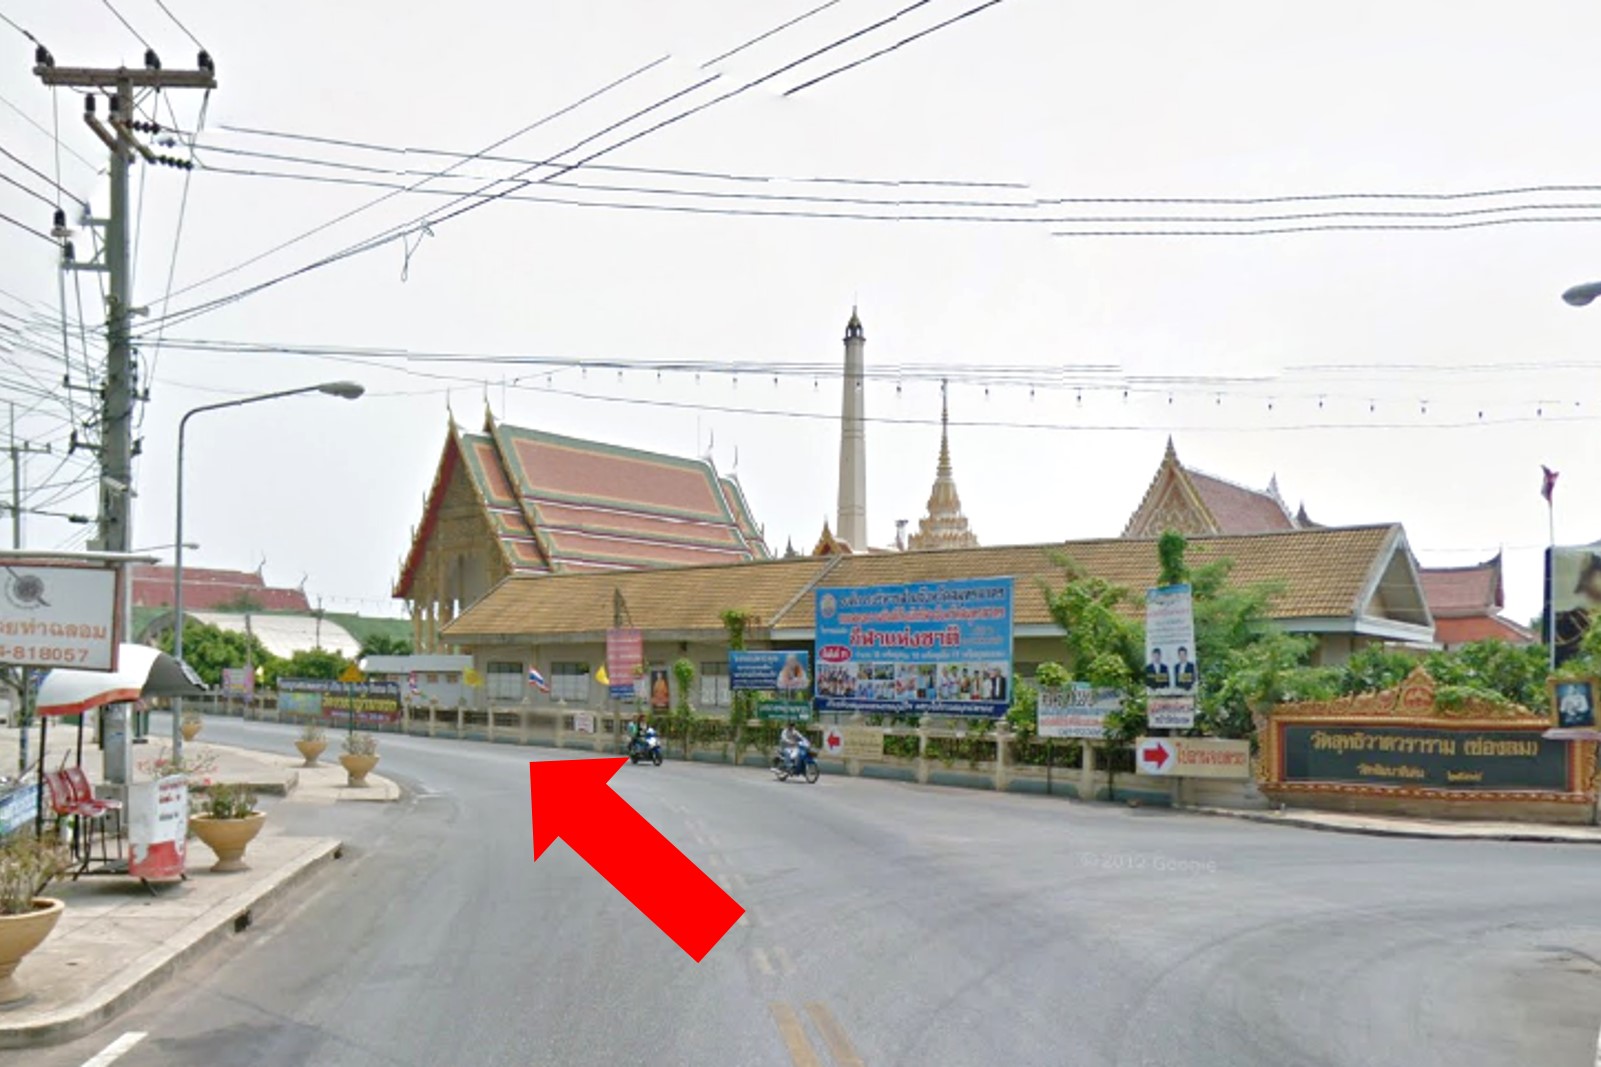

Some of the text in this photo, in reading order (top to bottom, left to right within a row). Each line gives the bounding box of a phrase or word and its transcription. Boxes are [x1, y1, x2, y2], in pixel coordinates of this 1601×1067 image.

[850, 624, 961, 648] กีฬาแห่งชาติ
[1310, 729, 1539, 756] วัดสุทธิวาตวราราม (ช่องลม)
